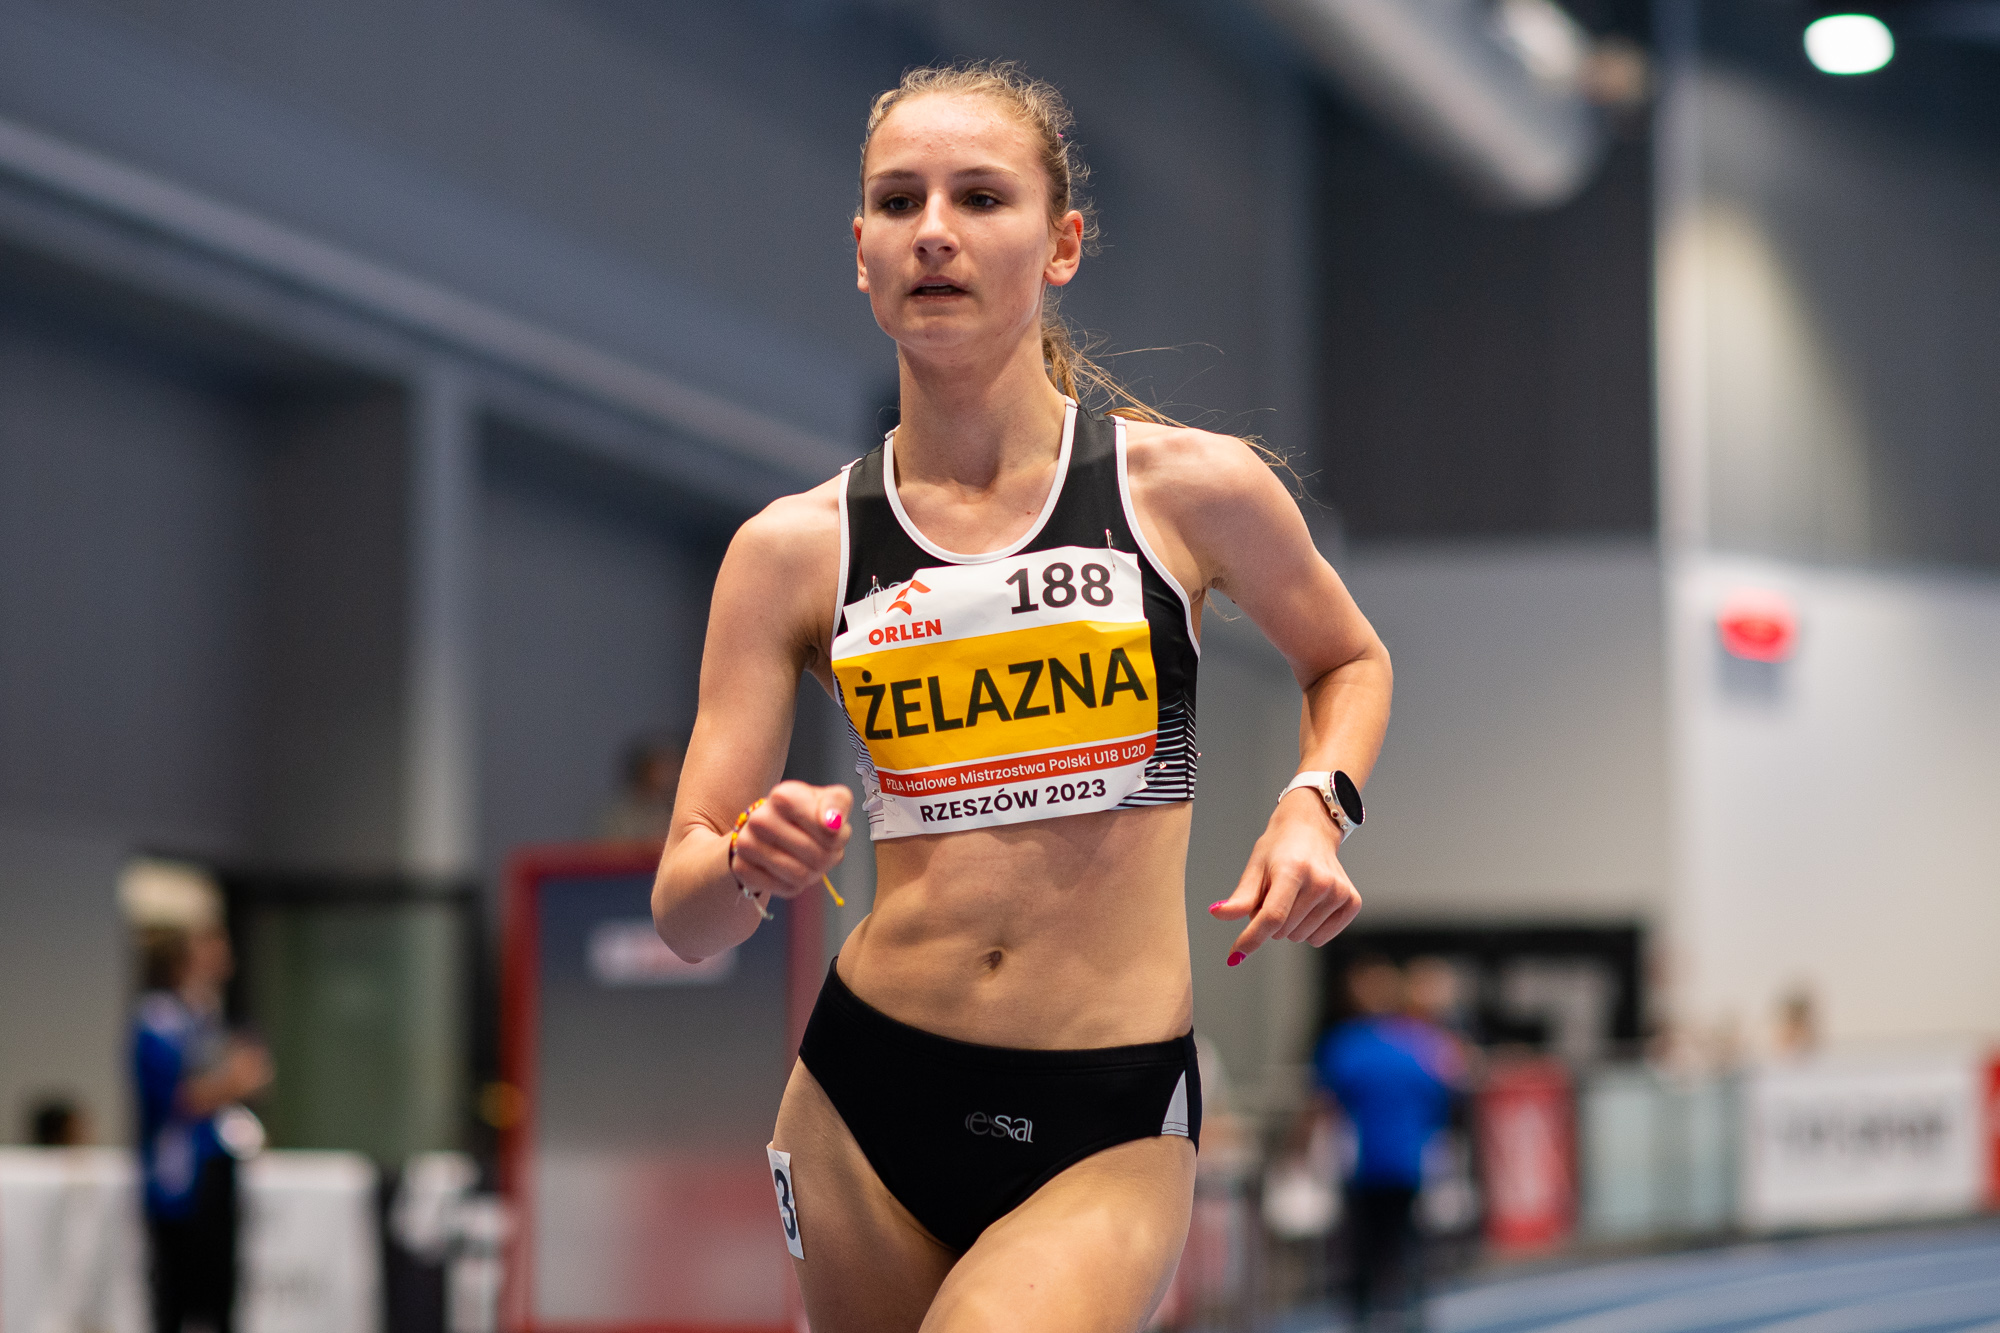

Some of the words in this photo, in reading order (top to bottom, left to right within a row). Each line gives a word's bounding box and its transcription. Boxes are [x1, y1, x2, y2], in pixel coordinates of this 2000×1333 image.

[1005, 562, 1114, 615] 188
[868, 618, 942, 645] ORLEN
[855, 648, 1149, 741] ŻELAZNA
[885, 778, 906, 792] PZLA
[906, 776, 957, 792] Halowe
[960, 763, 1046, 785] Mistrzostwa
[1049, 753, 1091, 772] Polski
[1094, 749, 1119, 764] U18
[1122, 743, 1146, 760] U20
[919, 787, 1038, 823] RZESZÓW
[1045, 778, 1107, 805] 2023
[774, 1168, 797, 1241] 3
